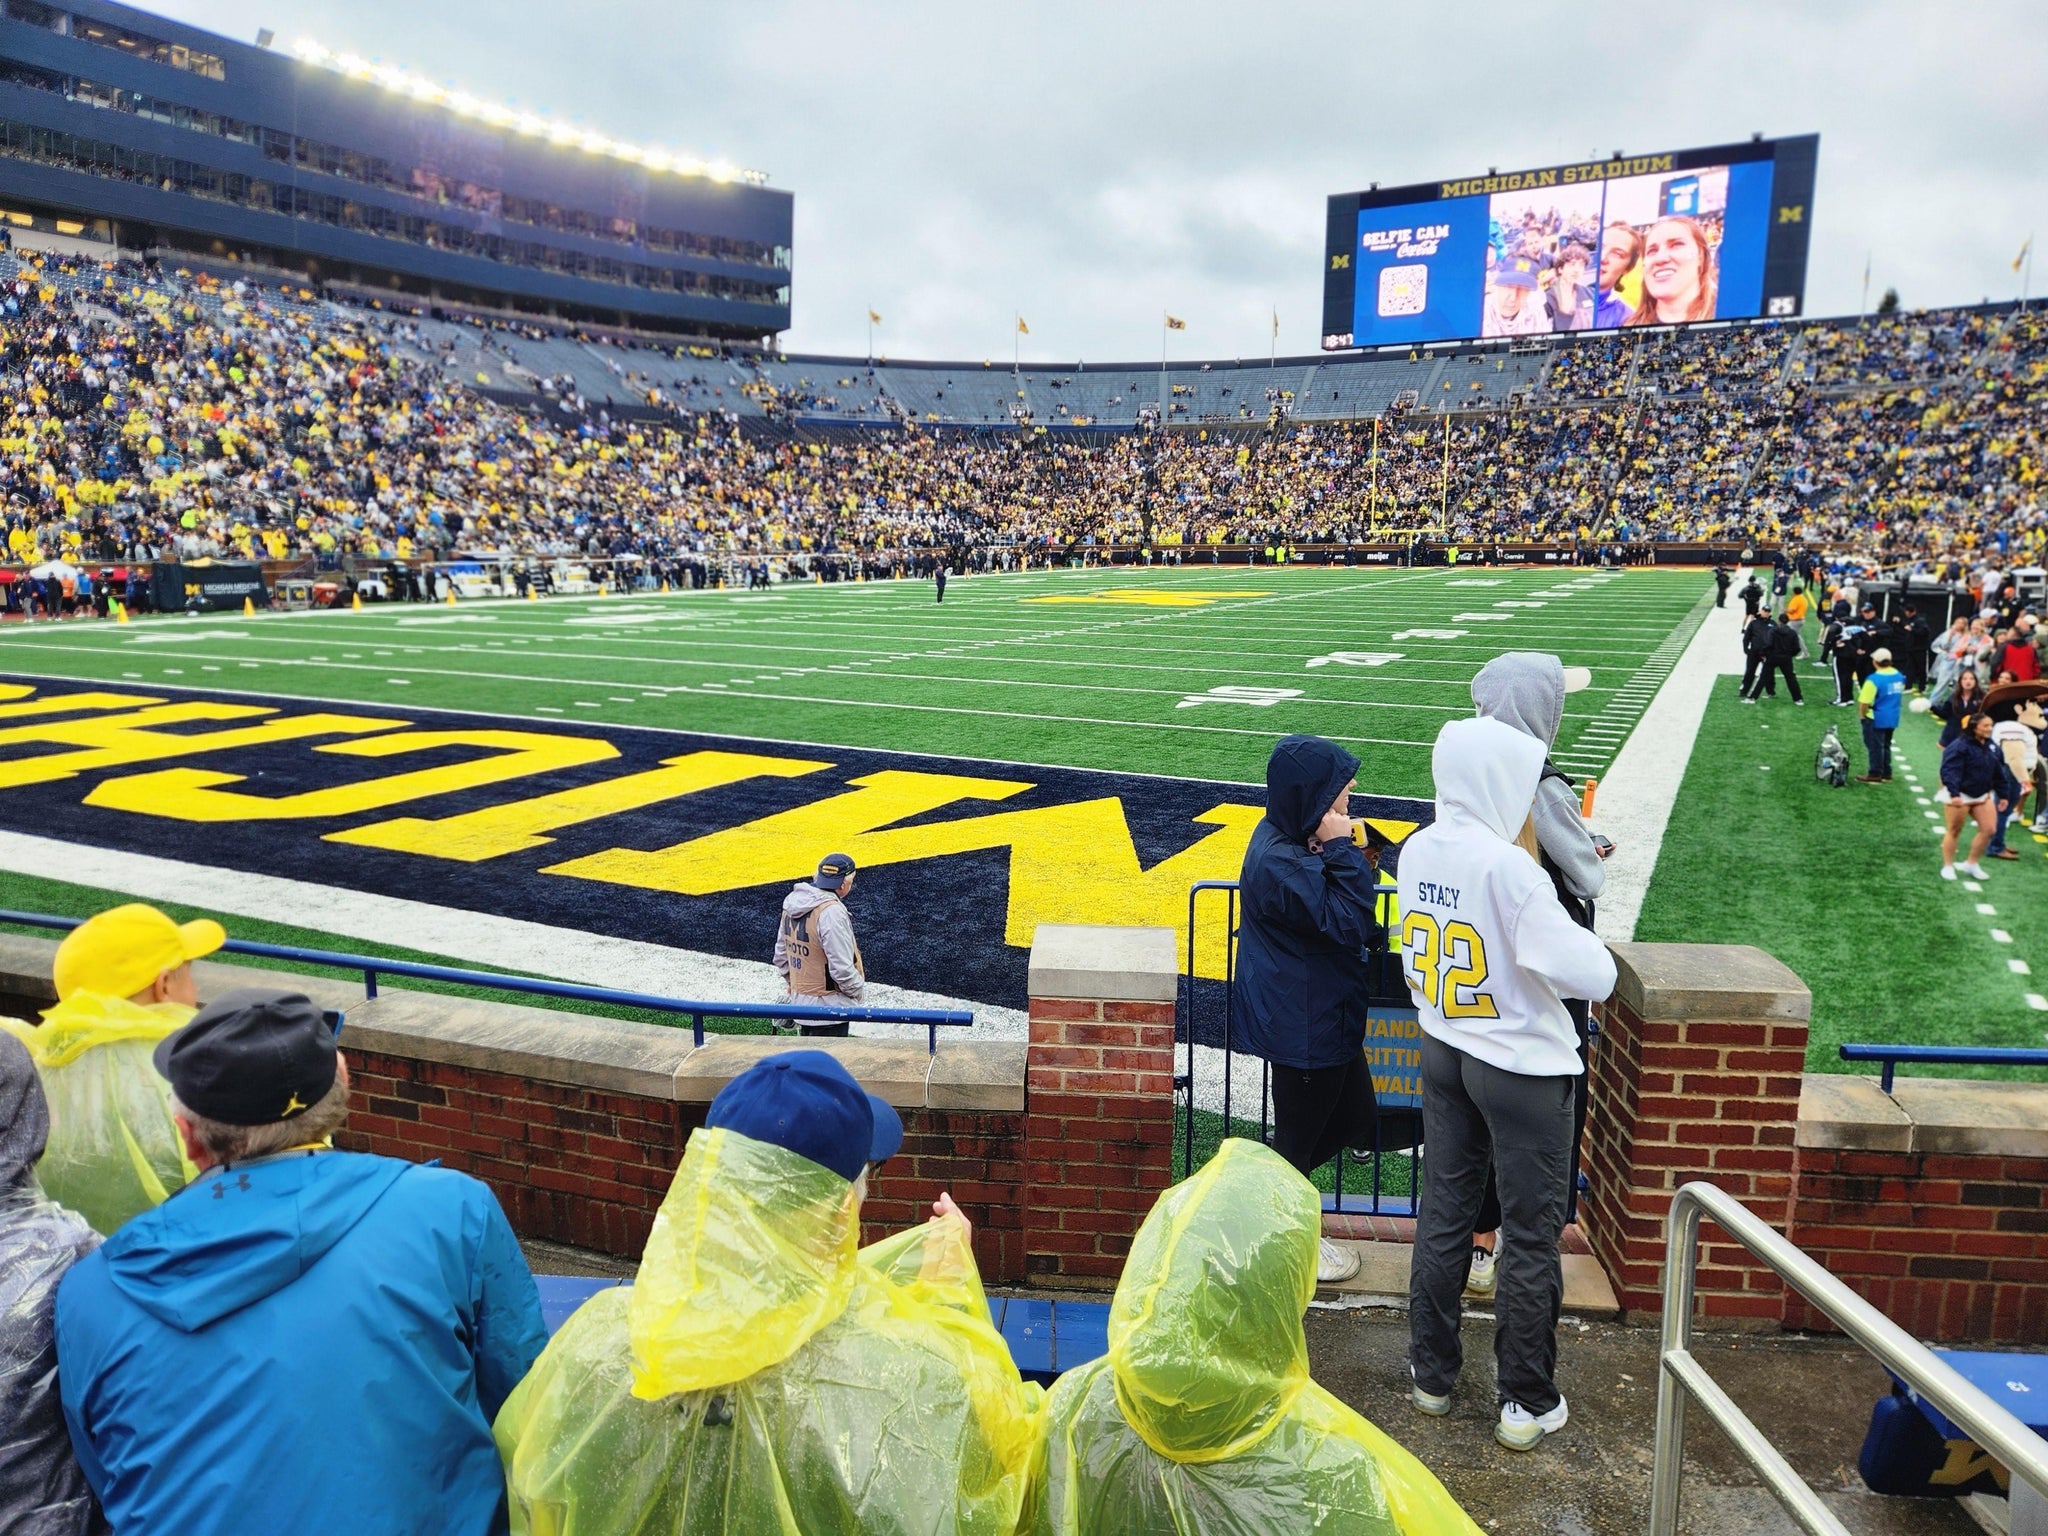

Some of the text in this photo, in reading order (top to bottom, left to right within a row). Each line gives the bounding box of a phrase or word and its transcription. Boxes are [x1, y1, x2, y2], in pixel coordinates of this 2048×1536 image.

[1442, 155, 1673, 198] MICHIGAN STADIUM
[1778, 205, 1803, 223] M
[1363, 224, 1450, 247] SELFIE CAM
[1331, 254, 1350, 270] M
[1367, 552, 1390, 561] meijer
[1545, 552, 1571, 561] meer
[184, 583, 201, 596] M
[1419, 882, 1460, 910] STACY
[1402, 909, 1500, 1019] 32
